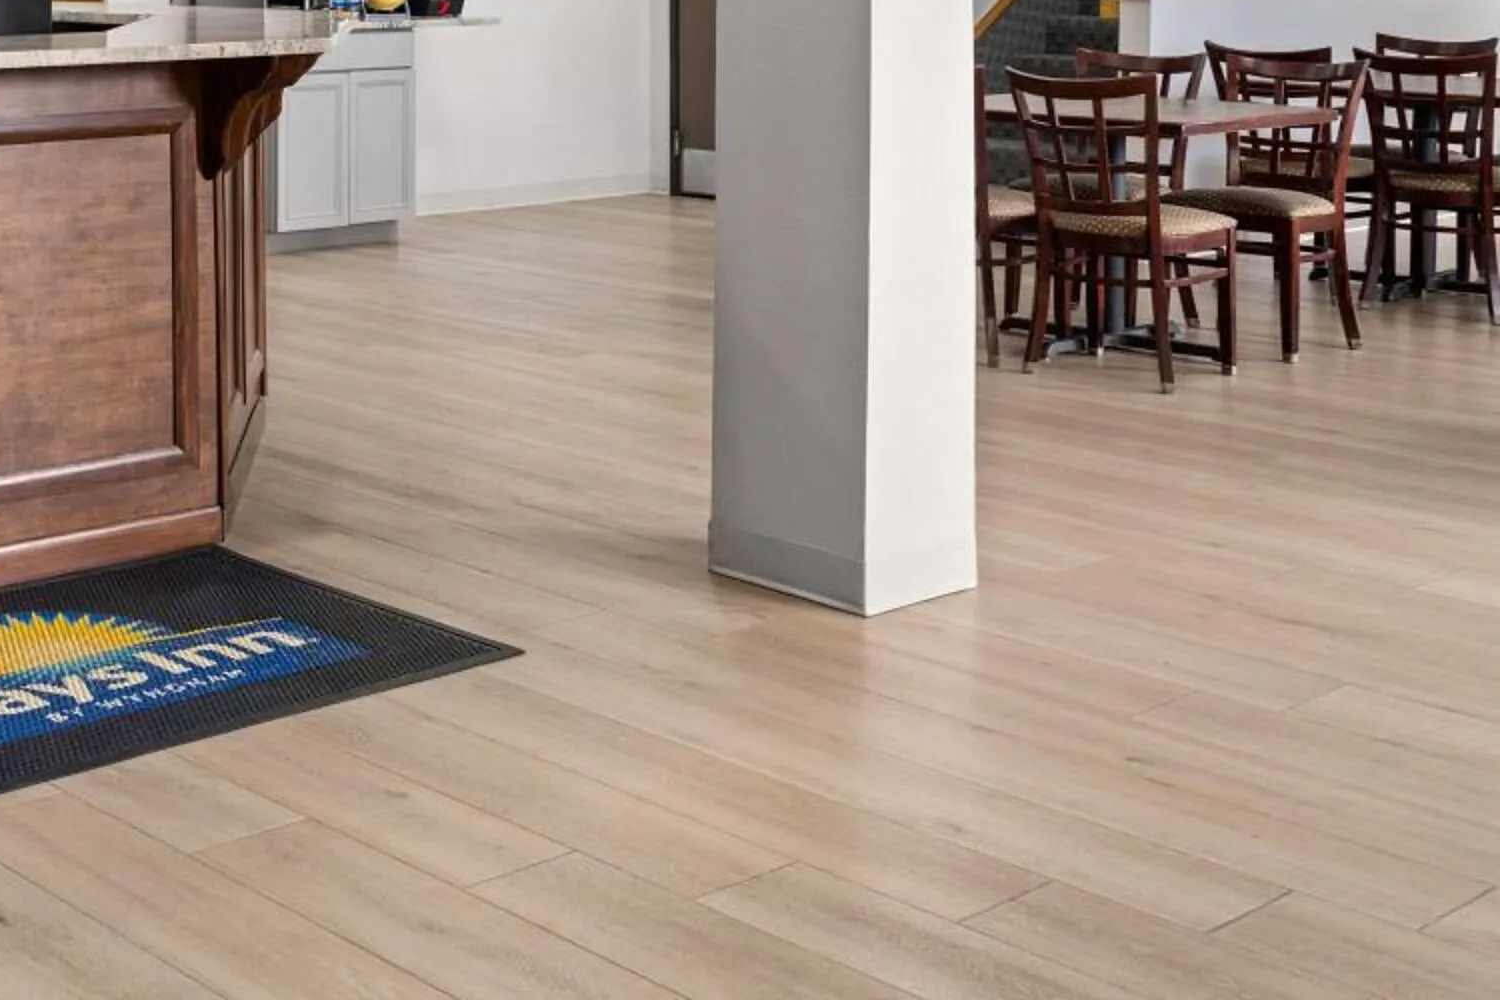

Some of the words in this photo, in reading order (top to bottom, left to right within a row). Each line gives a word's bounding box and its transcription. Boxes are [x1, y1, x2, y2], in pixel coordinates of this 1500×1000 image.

[132, 631, 307, 675] Inn
[45, 705, 85, 724] BY
[94, 668, 247, 710] WYNDHAM
